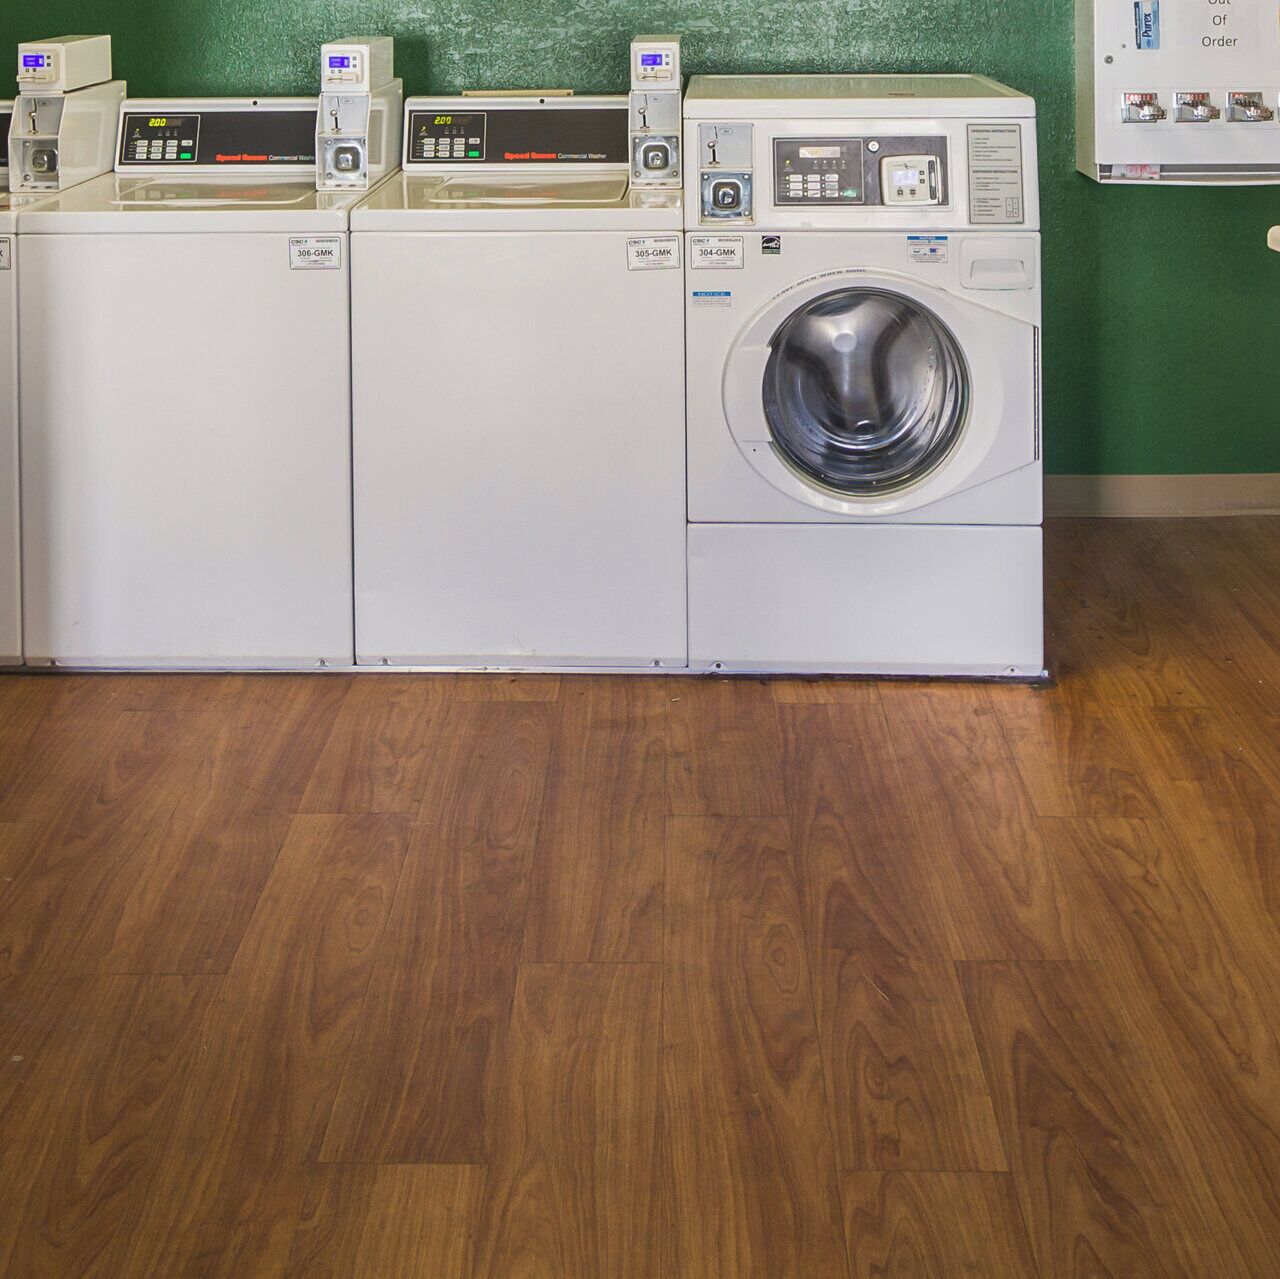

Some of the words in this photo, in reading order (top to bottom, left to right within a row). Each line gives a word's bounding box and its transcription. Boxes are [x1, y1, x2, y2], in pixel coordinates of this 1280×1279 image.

[1212, 14, 1228, 26] Of
[1141, 12, 1153, 39] Purex
[1201, 36, 1239, 47] Order
[215, 154, 241, 163] Speed
[241, 153, 268, 161] Queen
[504, 152, 530, 160] Speed
[530, 151, 557, 159] Queen
[297, 249, 334, 257] 306-GMK
[635, 249, 672, 258] 305-GMK
[699, 249, 736, 257] 304-GMK
